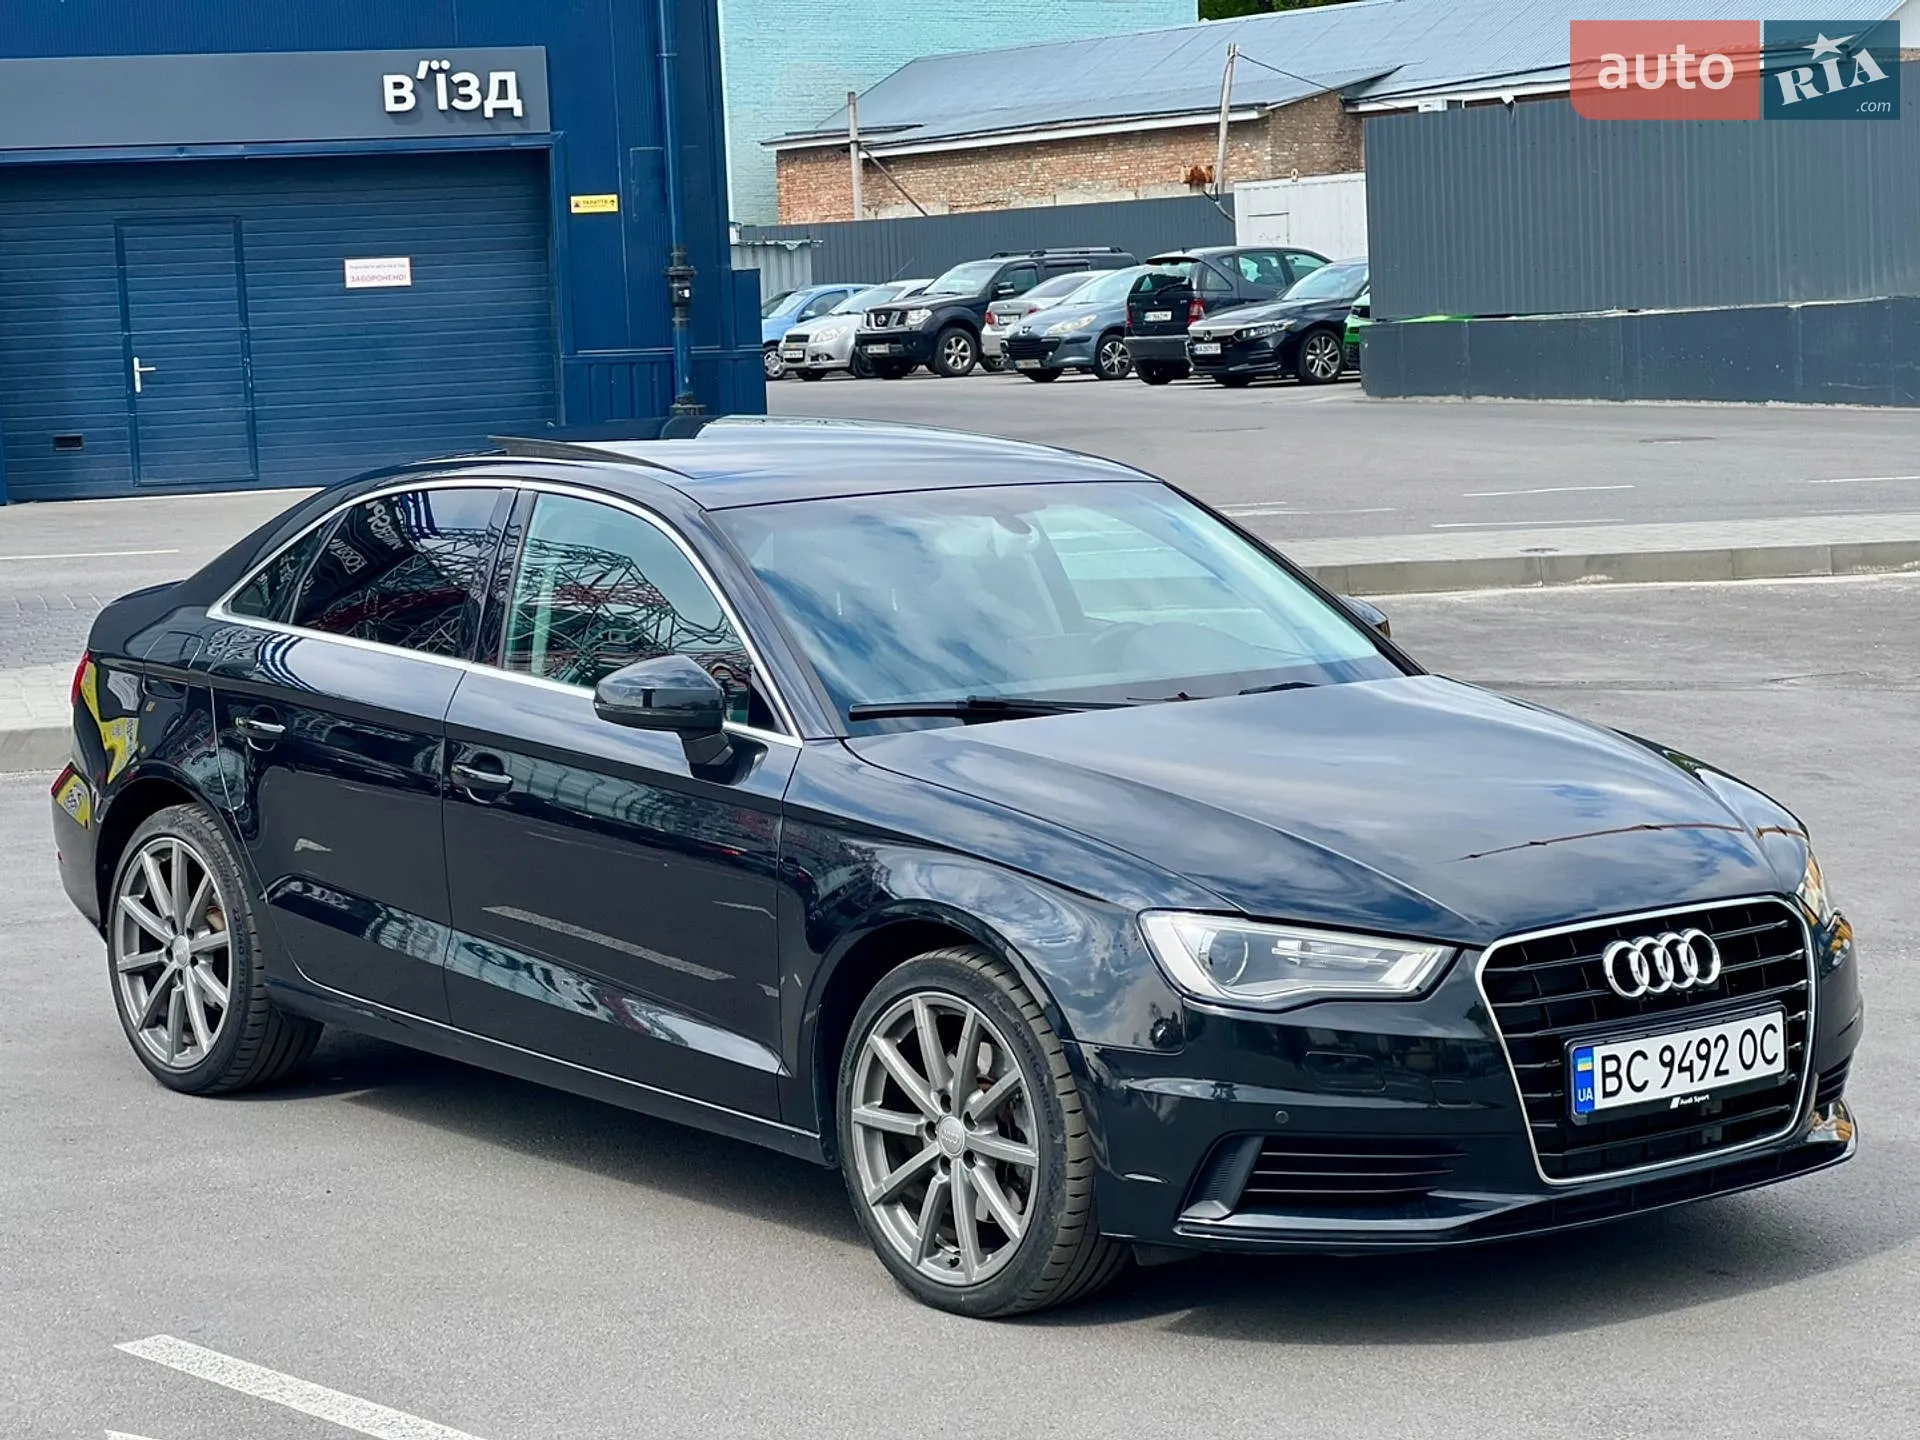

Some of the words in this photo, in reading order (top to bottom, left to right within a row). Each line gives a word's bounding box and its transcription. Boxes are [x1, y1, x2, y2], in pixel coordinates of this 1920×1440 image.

[1601, 1050, 1649, 1099] BC
[1658, 1034, 1729, 1089] 9492
[1738, 1023, 1779, 1071] OC
[1577, 1088, 1594, 1102] UA
